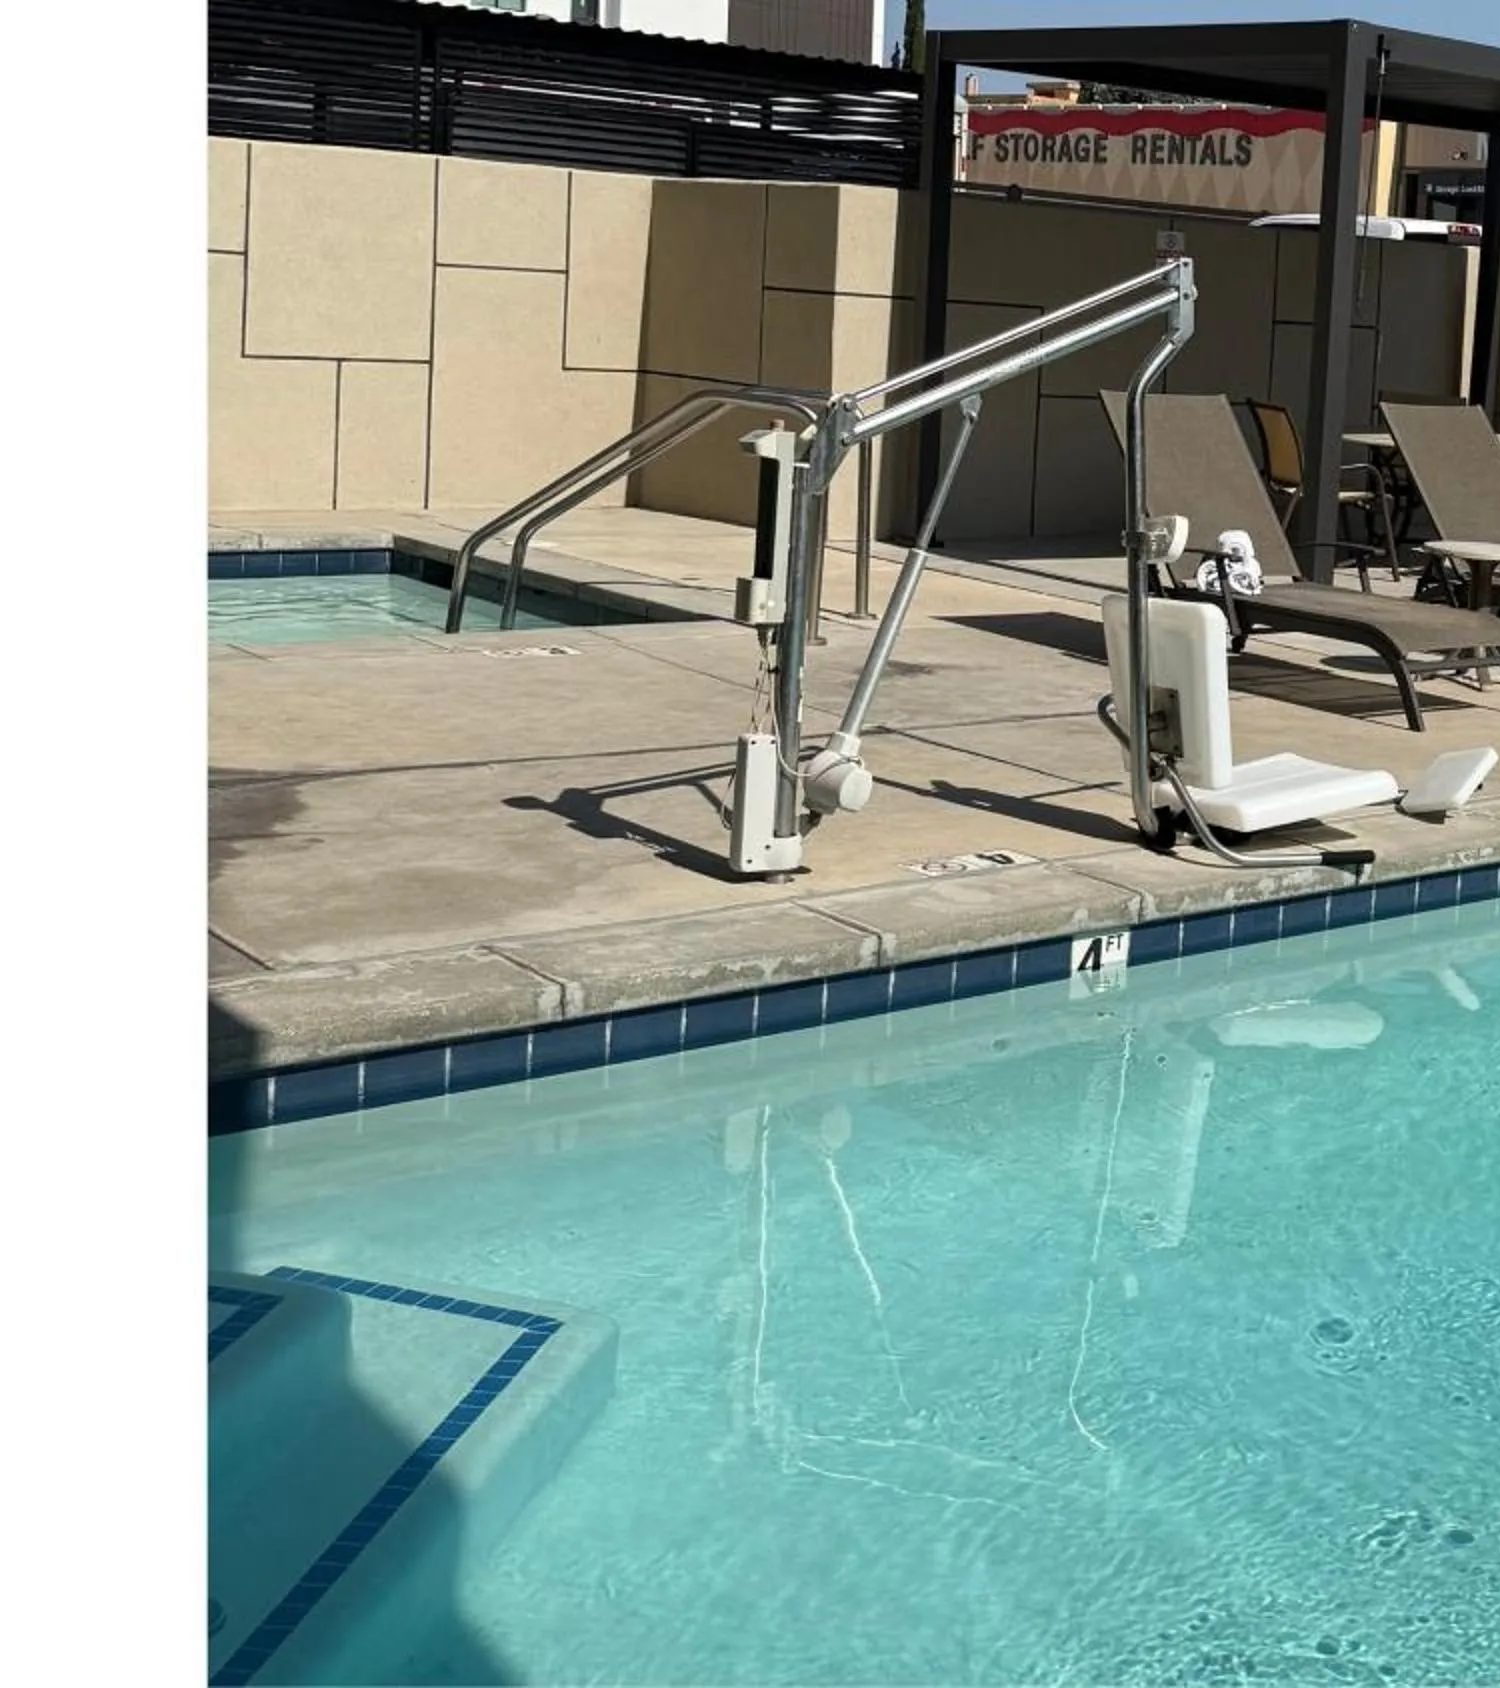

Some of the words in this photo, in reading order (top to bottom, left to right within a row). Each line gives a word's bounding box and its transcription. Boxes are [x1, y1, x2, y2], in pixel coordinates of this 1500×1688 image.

[994, 132, 1109, 163] STORAGE
[1130, 132, 1253, 167] RENTALS
[1078, 936, 1104, 972] 4
[1105, 932, 1124, 953] FT
